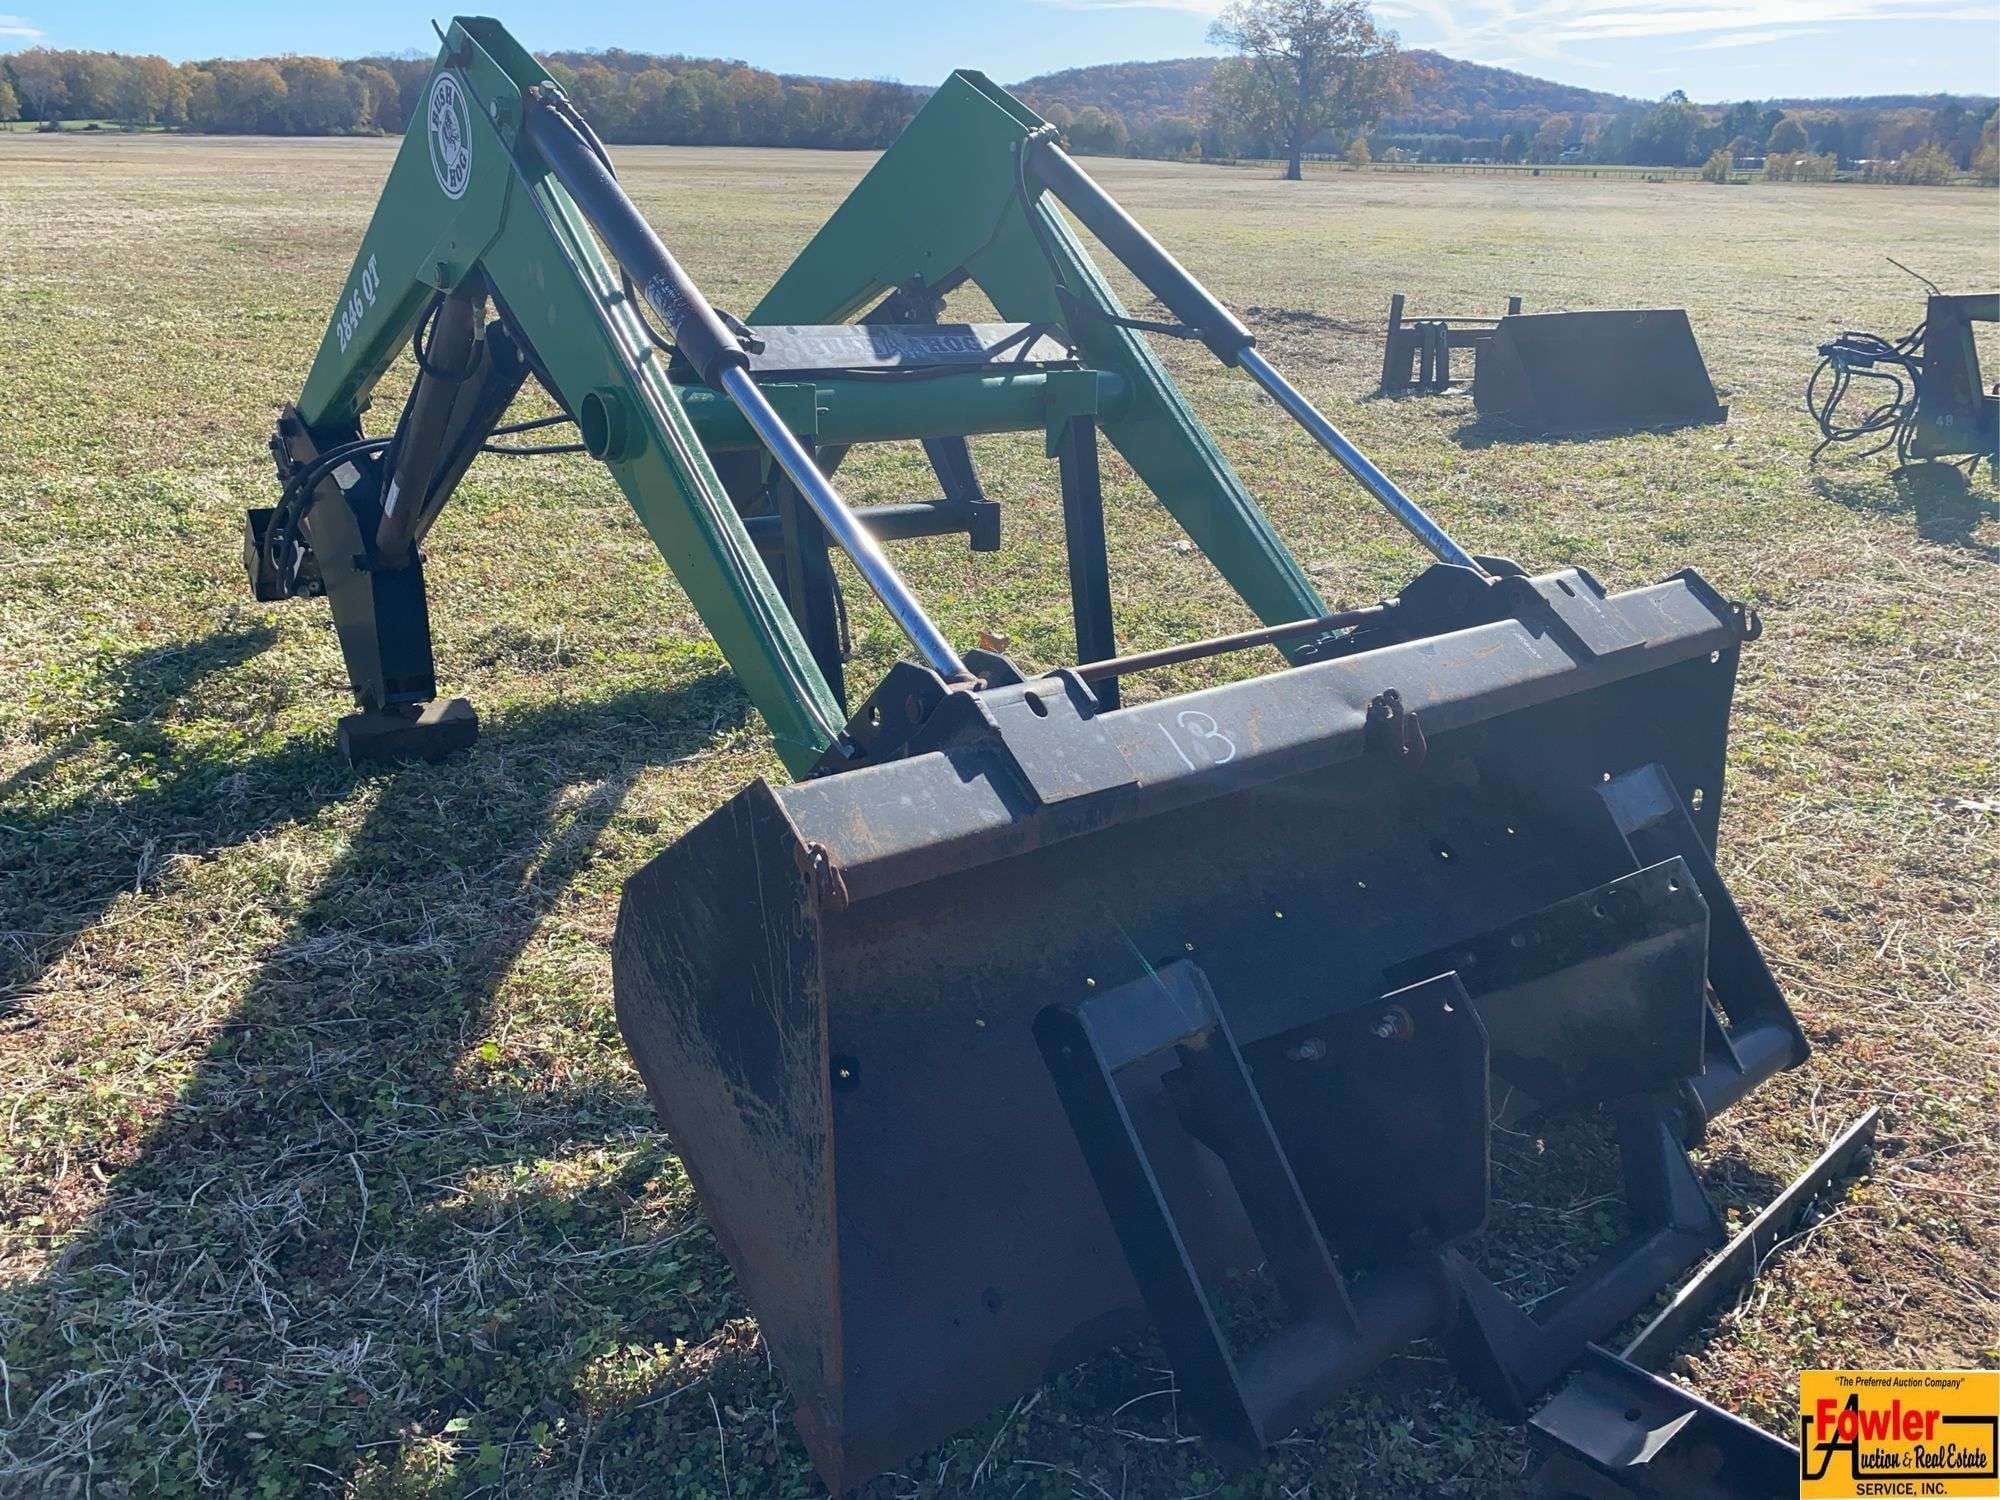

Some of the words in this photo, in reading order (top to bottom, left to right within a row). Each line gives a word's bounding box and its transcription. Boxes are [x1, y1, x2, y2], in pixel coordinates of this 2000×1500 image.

[432, 85, 453, 127] BUSH
[449, 151, 467, 188] HOG
[337, 288, 363, 354] 2846
[363, 253, 380, 307] QT
[1157, 710, 1236, 771] 13
